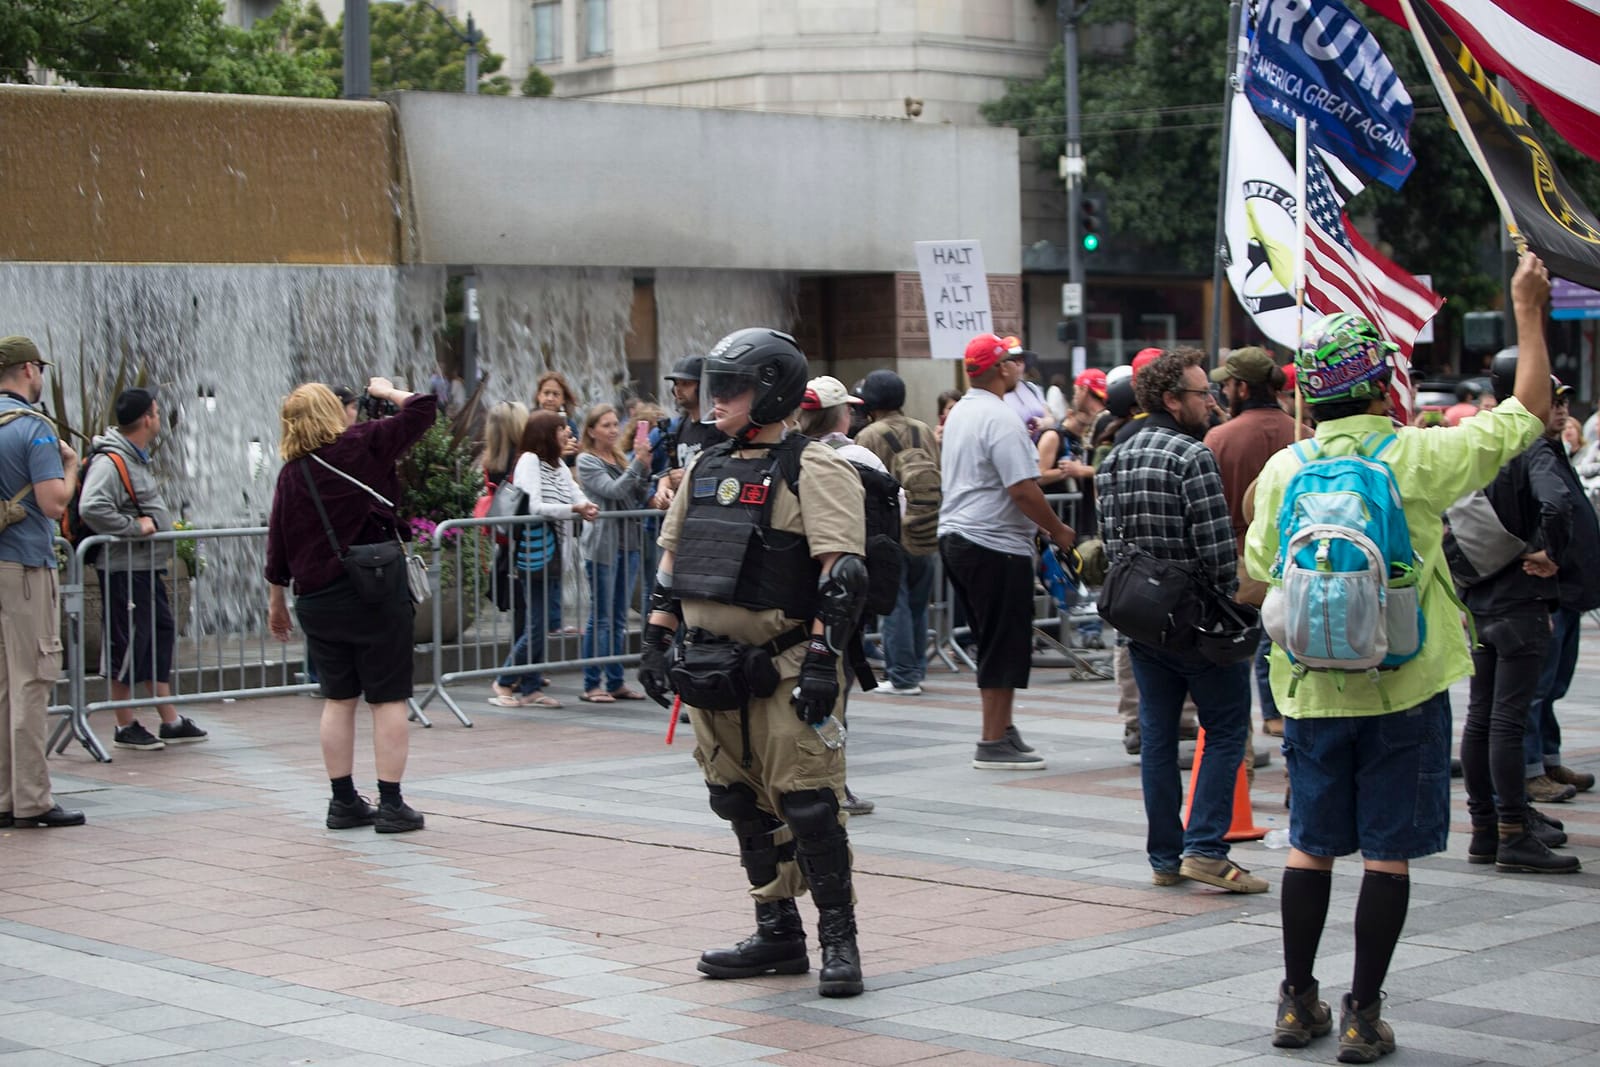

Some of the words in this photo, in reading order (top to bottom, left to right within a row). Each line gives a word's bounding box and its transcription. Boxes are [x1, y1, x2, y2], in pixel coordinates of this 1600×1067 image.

[1267, 0, 1413, 113] RUMP
[1256, 55, 1303, 99] AMERICA
[1303, 84, 1362, 123] GREAT
[932, 247, 973, 265] HALT
[940, 285, 973, 304] ALT
[934, 310, 987, 331] RIGHT
